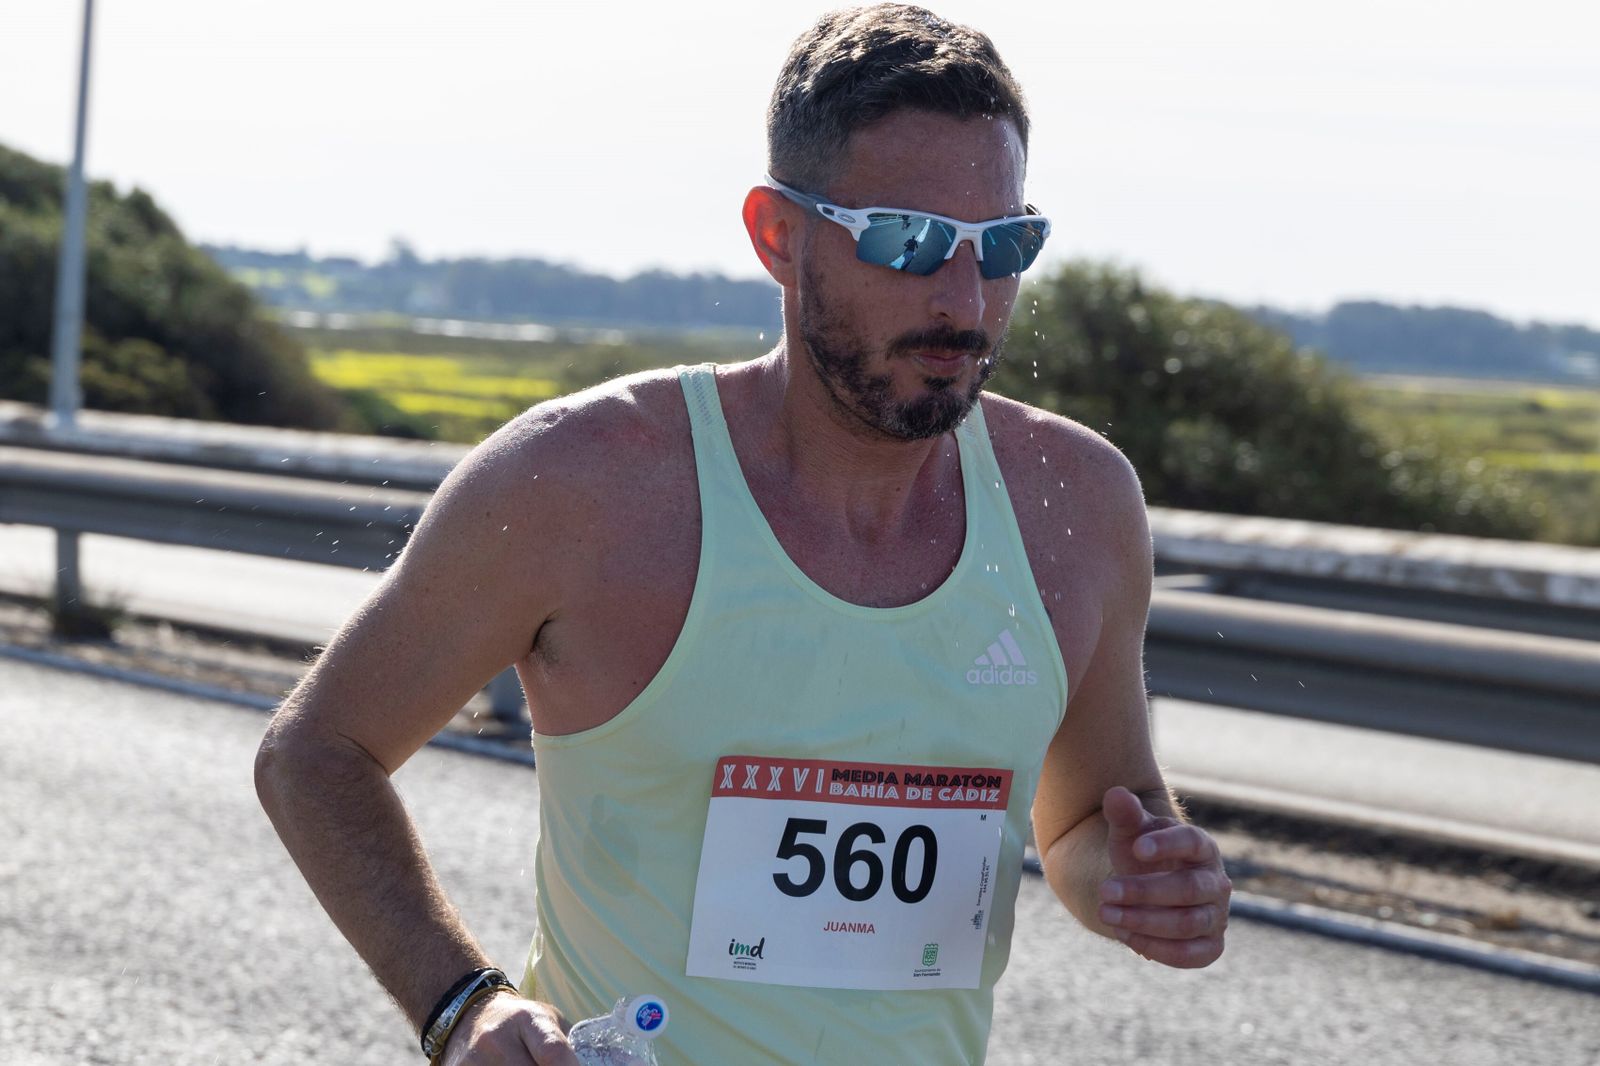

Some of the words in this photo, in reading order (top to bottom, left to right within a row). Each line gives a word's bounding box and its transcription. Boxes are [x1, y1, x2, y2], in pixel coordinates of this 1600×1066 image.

[966, 664, 1038, 685] adidas
[831, 768, 899, 785] MEDIA
[903, 772, 1002, 788] MARATÓN
[829, 782, 899, 799] BAHÍA
[906, 787, 932, 801] DE
[938, 785, 1001, 802] CÁDIZ
[772, 817, 938, 904] 560
[823, 921, 875, 934] JUANMA
[728, 936, 765, 960] imd
